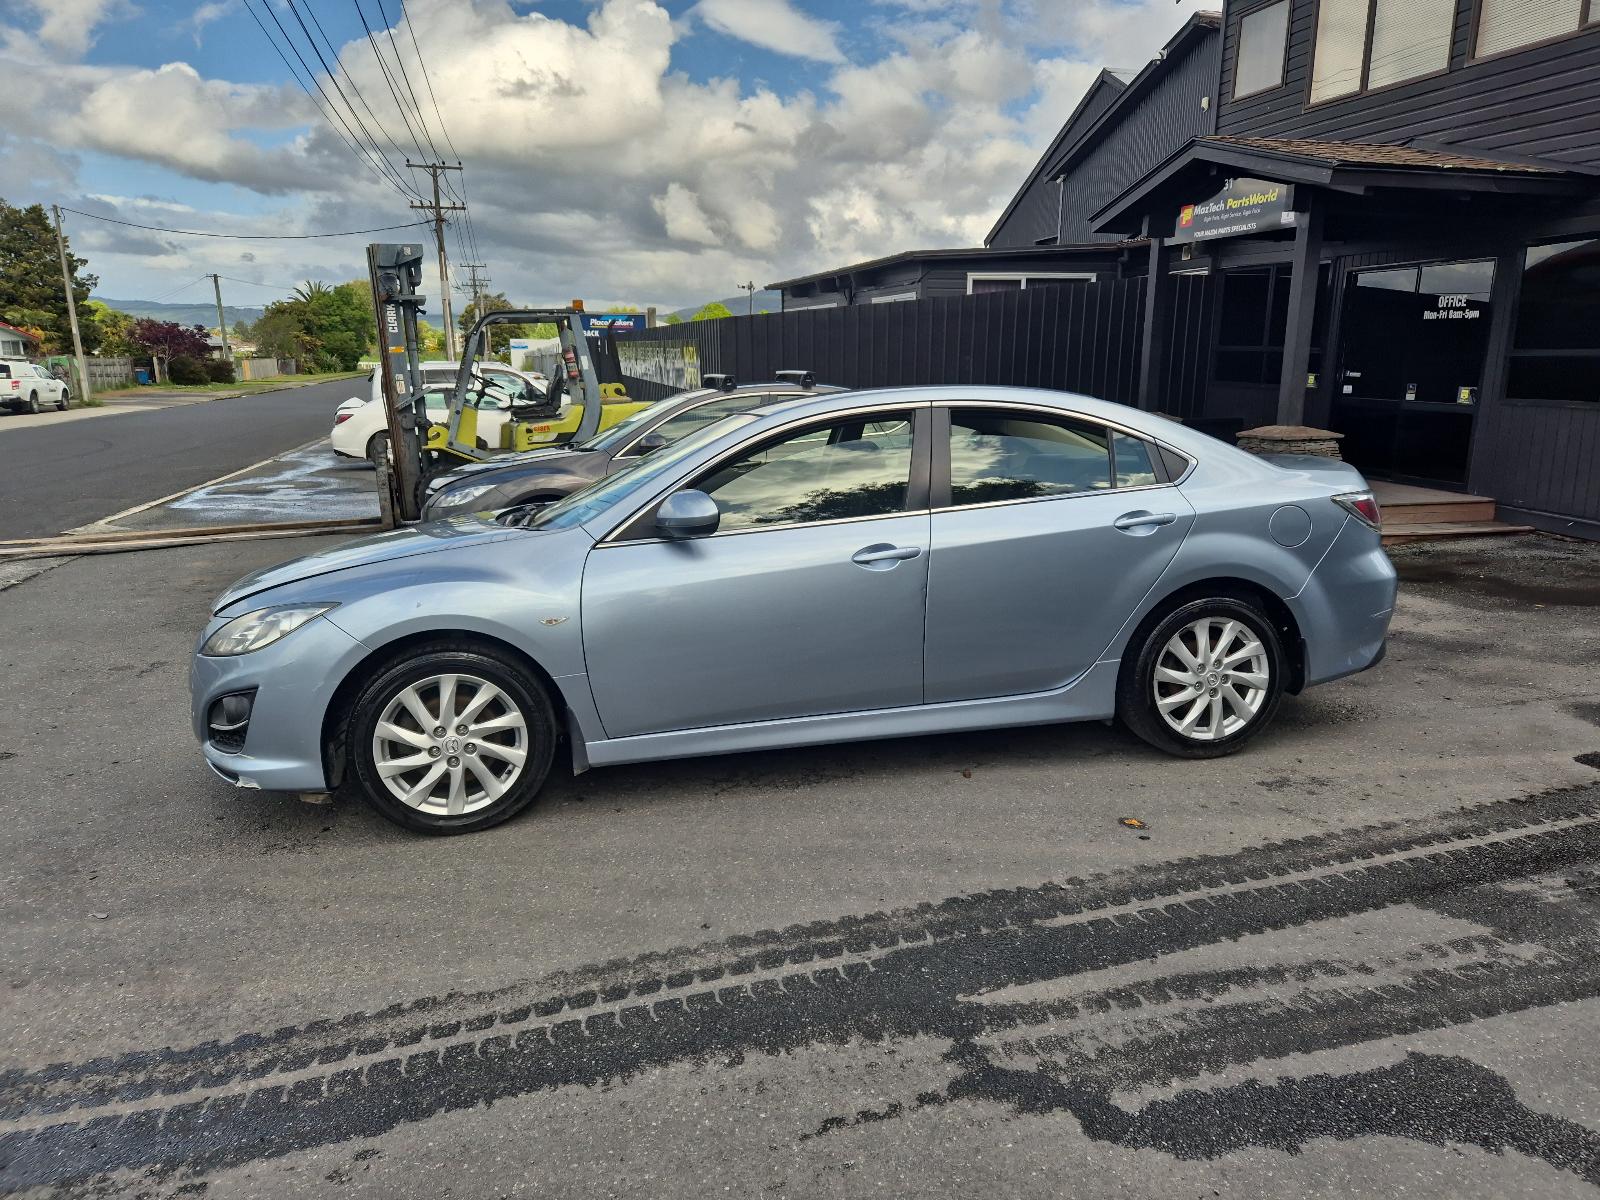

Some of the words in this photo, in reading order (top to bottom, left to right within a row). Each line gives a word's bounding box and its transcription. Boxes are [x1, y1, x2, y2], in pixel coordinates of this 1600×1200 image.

[1193, 200, 1225, 215] MazTech
[1226, 188, 1279, 210] PartsWorld
[1218, 227, 1231, 235] PARTS
[1231, 222, 1257, 233] SPECIALISTS
[1438, 295, 1468, 308] OFFICE
[386, 303, 398, 333] CLARK
[1423, 309, 1448, 320] Mon-Fri
